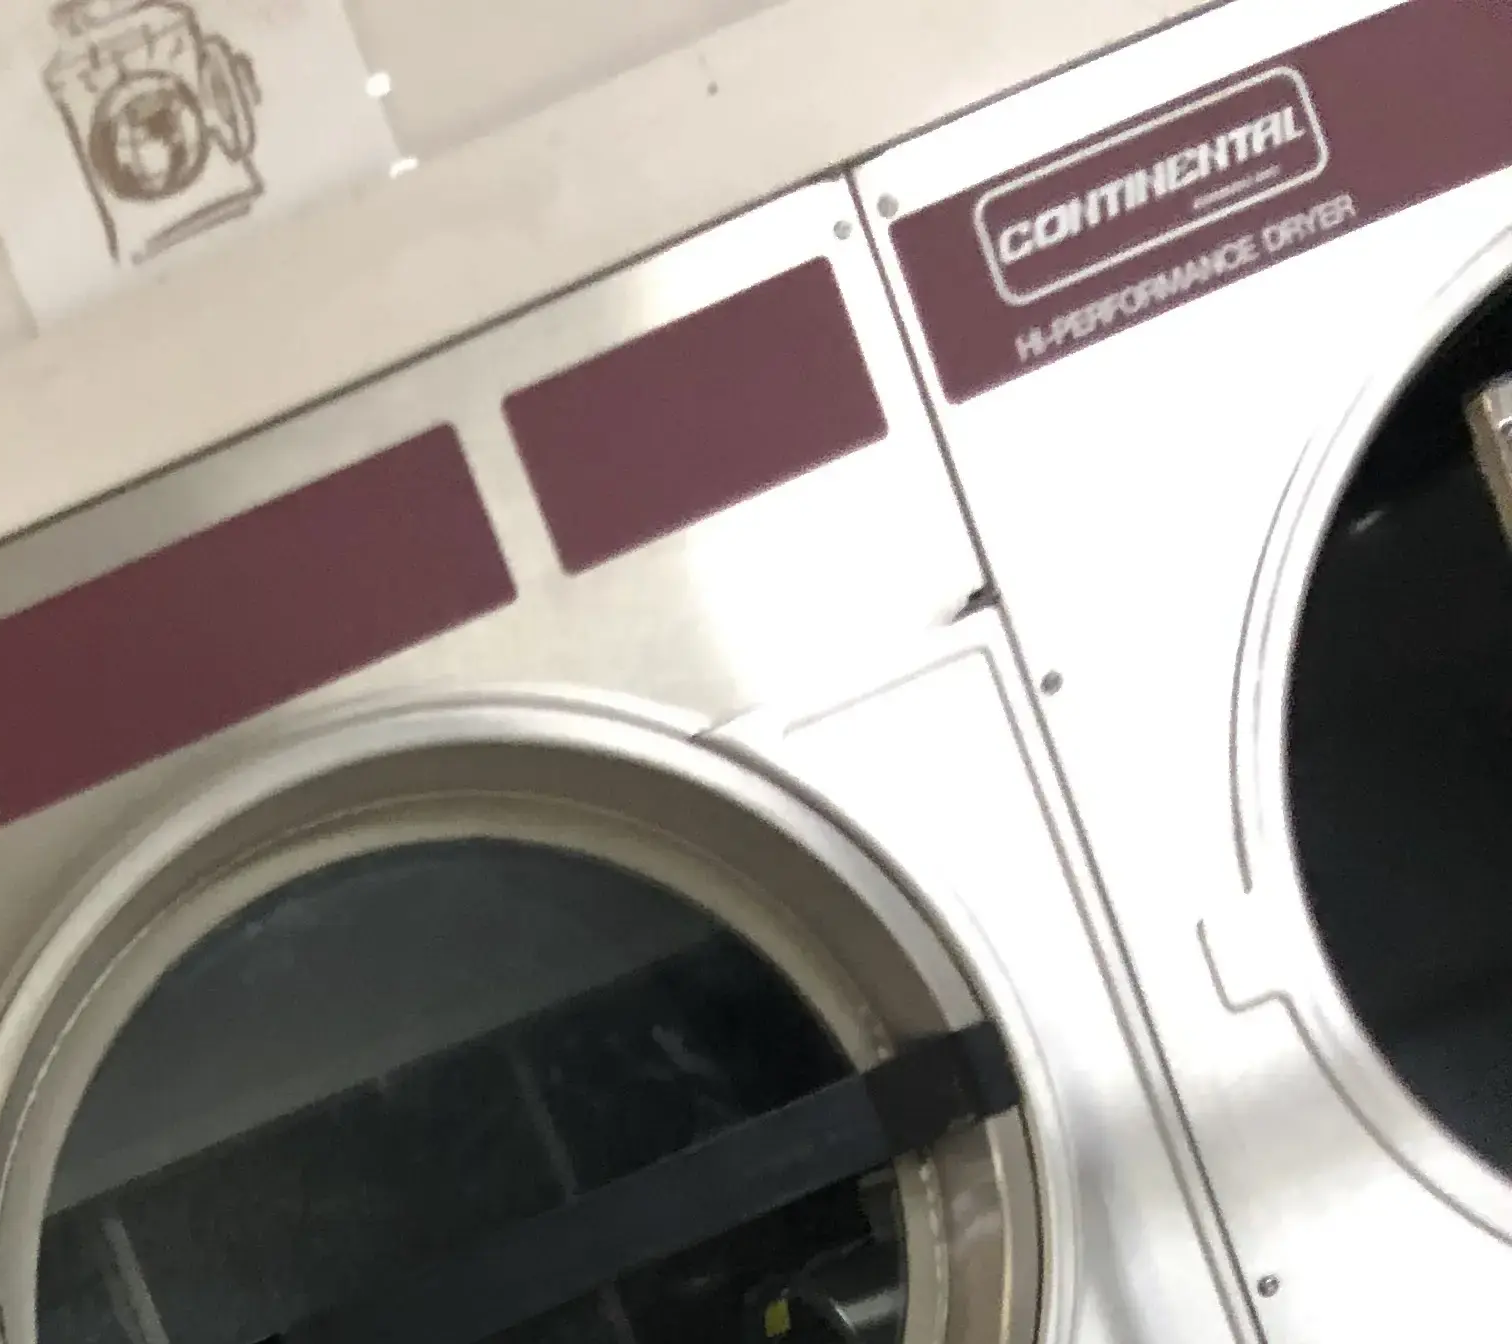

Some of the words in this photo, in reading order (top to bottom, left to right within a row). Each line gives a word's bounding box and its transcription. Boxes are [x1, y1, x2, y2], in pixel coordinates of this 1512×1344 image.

[999, 106, 1306, 264] CONTINENTAL
[1015, 239, 1260, 362] HI-PERFORMANCE
[1262, 194, 1358, 254] DRYER
